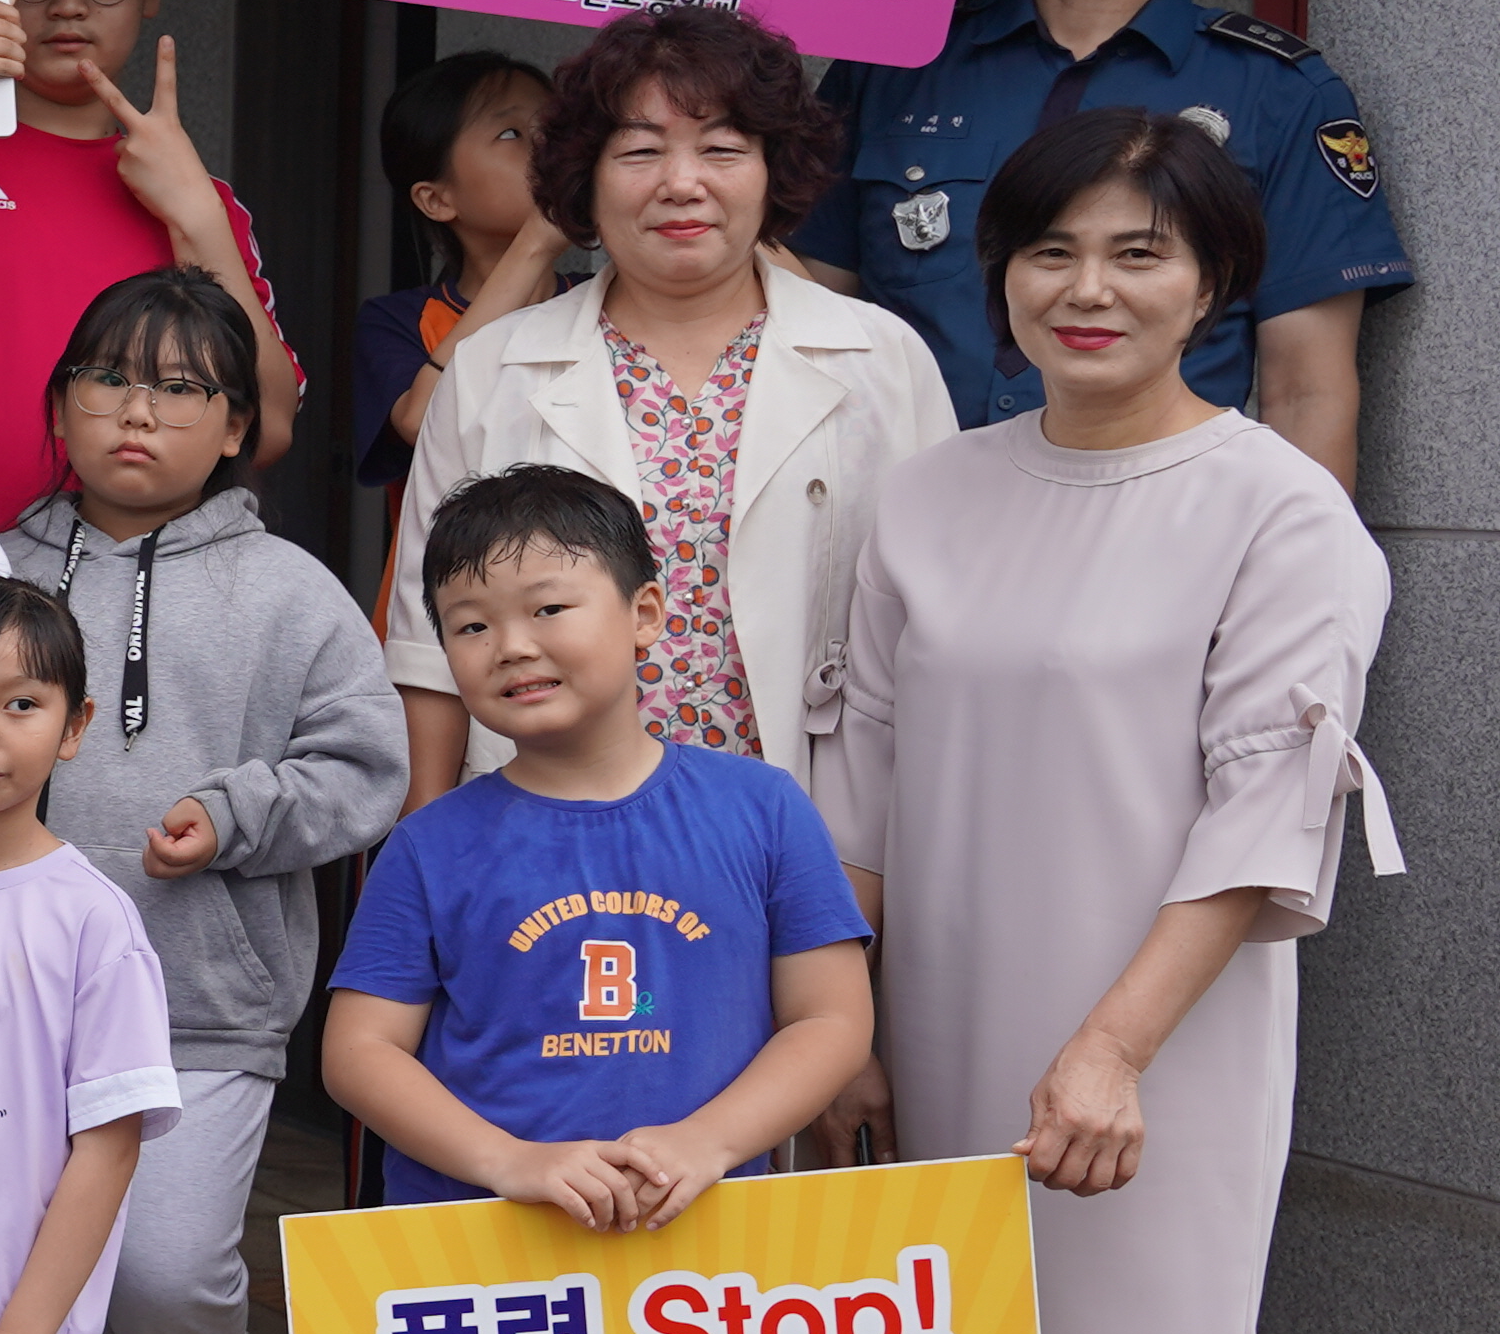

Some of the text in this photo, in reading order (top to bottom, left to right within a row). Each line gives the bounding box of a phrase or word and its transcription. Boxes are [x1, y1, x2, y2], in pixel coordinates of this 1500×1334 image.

[508, 890, 712, 953] UNITED COLORS OF
[578, 939, 637, 1021] B
[541, 1029, 671, 1058] BENETTON
